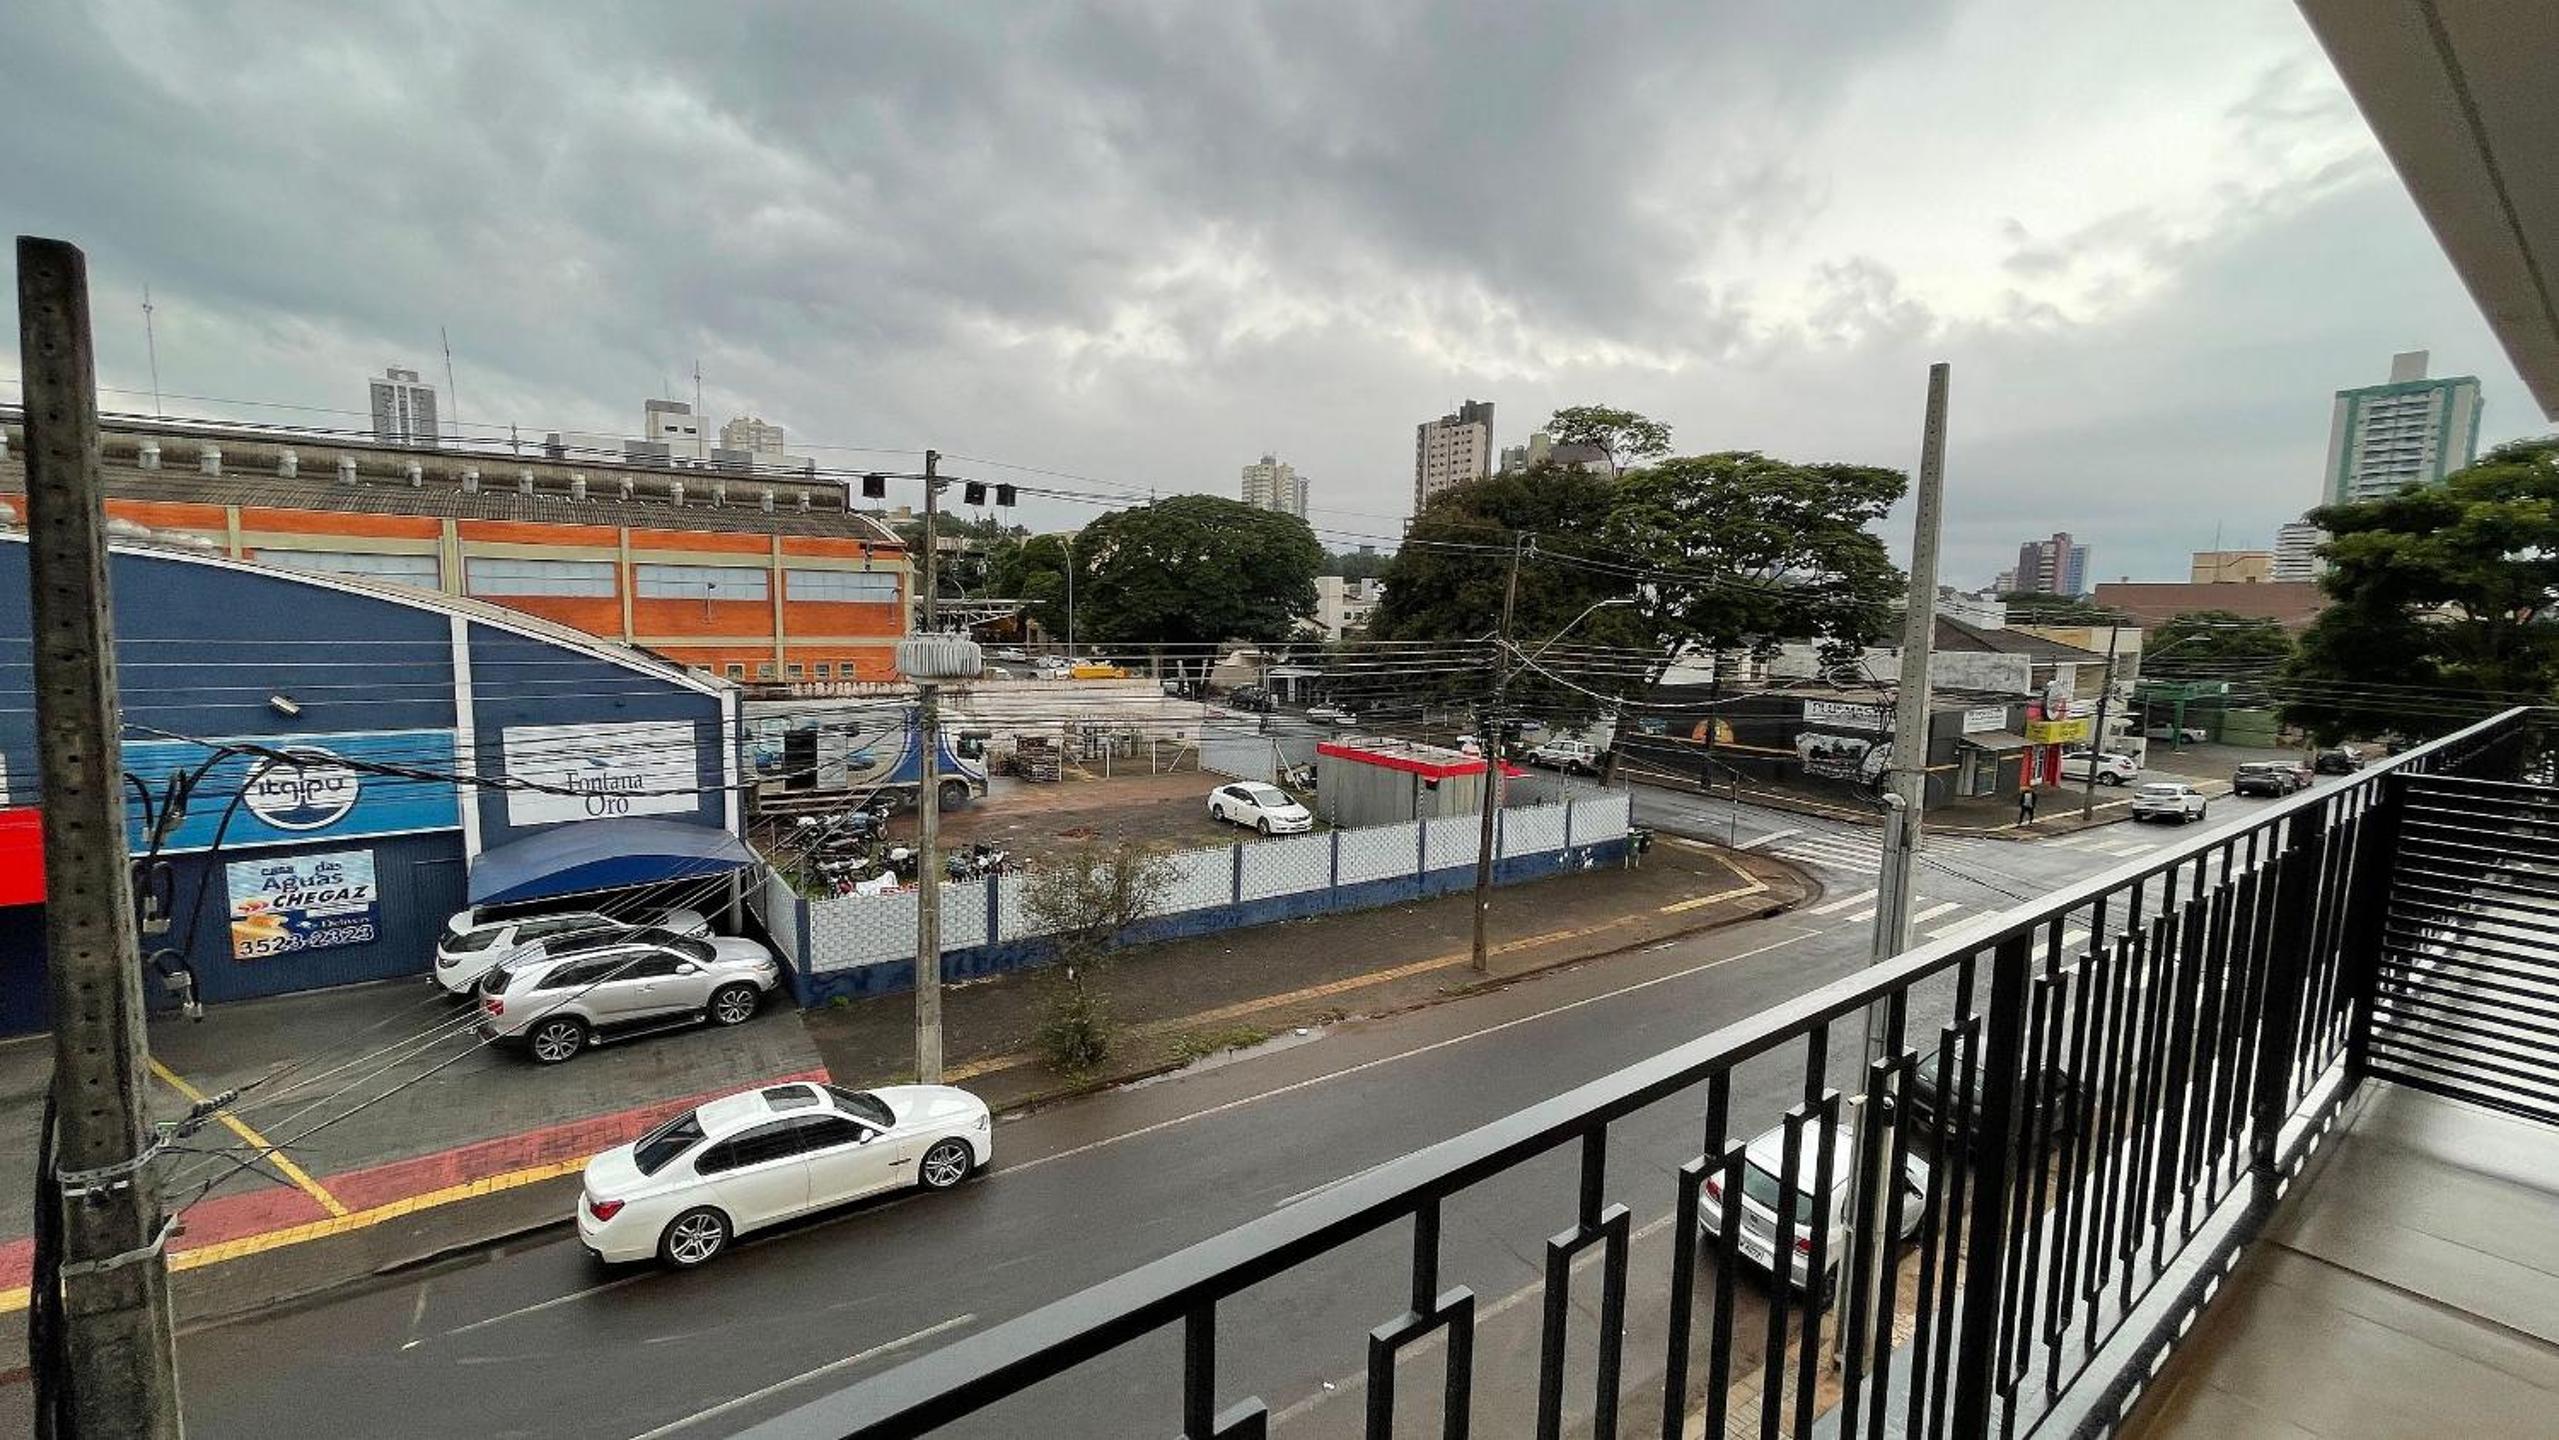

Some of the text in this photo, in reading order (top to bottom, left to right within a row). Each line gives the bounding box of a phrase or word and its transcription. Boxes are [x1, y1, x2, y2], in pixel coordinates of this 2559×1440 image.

[566, 771, 644, 793] Fontana
[585, 793, 629, 816] Oro
[315, 861, 341, 873] das
[273, 885, 369, 908] CHEGAZ
